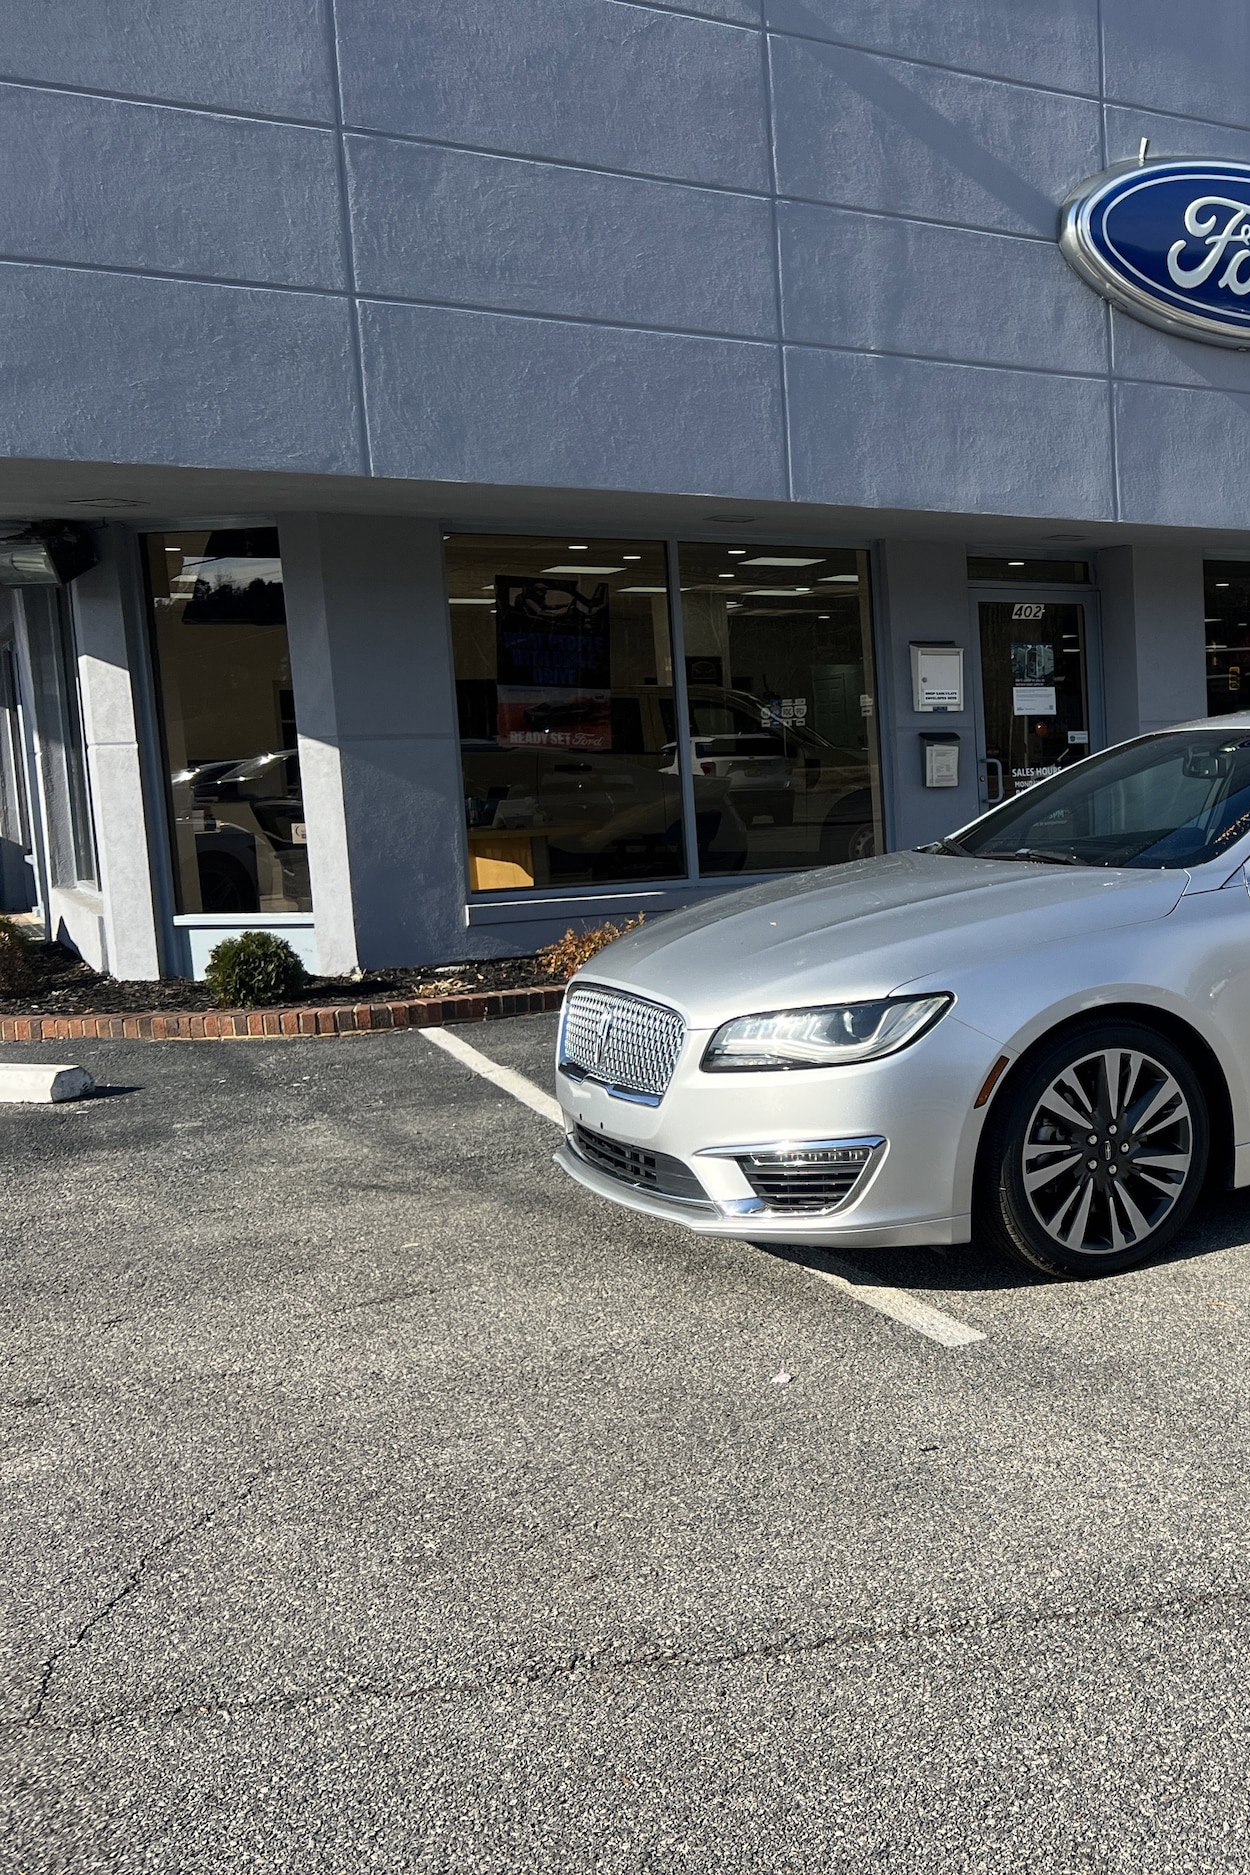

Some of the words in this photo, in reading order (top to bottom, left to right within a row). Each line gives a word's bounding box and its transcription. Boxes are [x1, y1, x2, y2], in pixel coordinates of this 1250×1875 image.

[1013, 605, 1043, 619] 402
[509, 731, 549, 745] READY
[550, 732, 571, 745] SET
[572, 733, 604, 746] Ford
[1011, 768, 1035, 778] SALES
